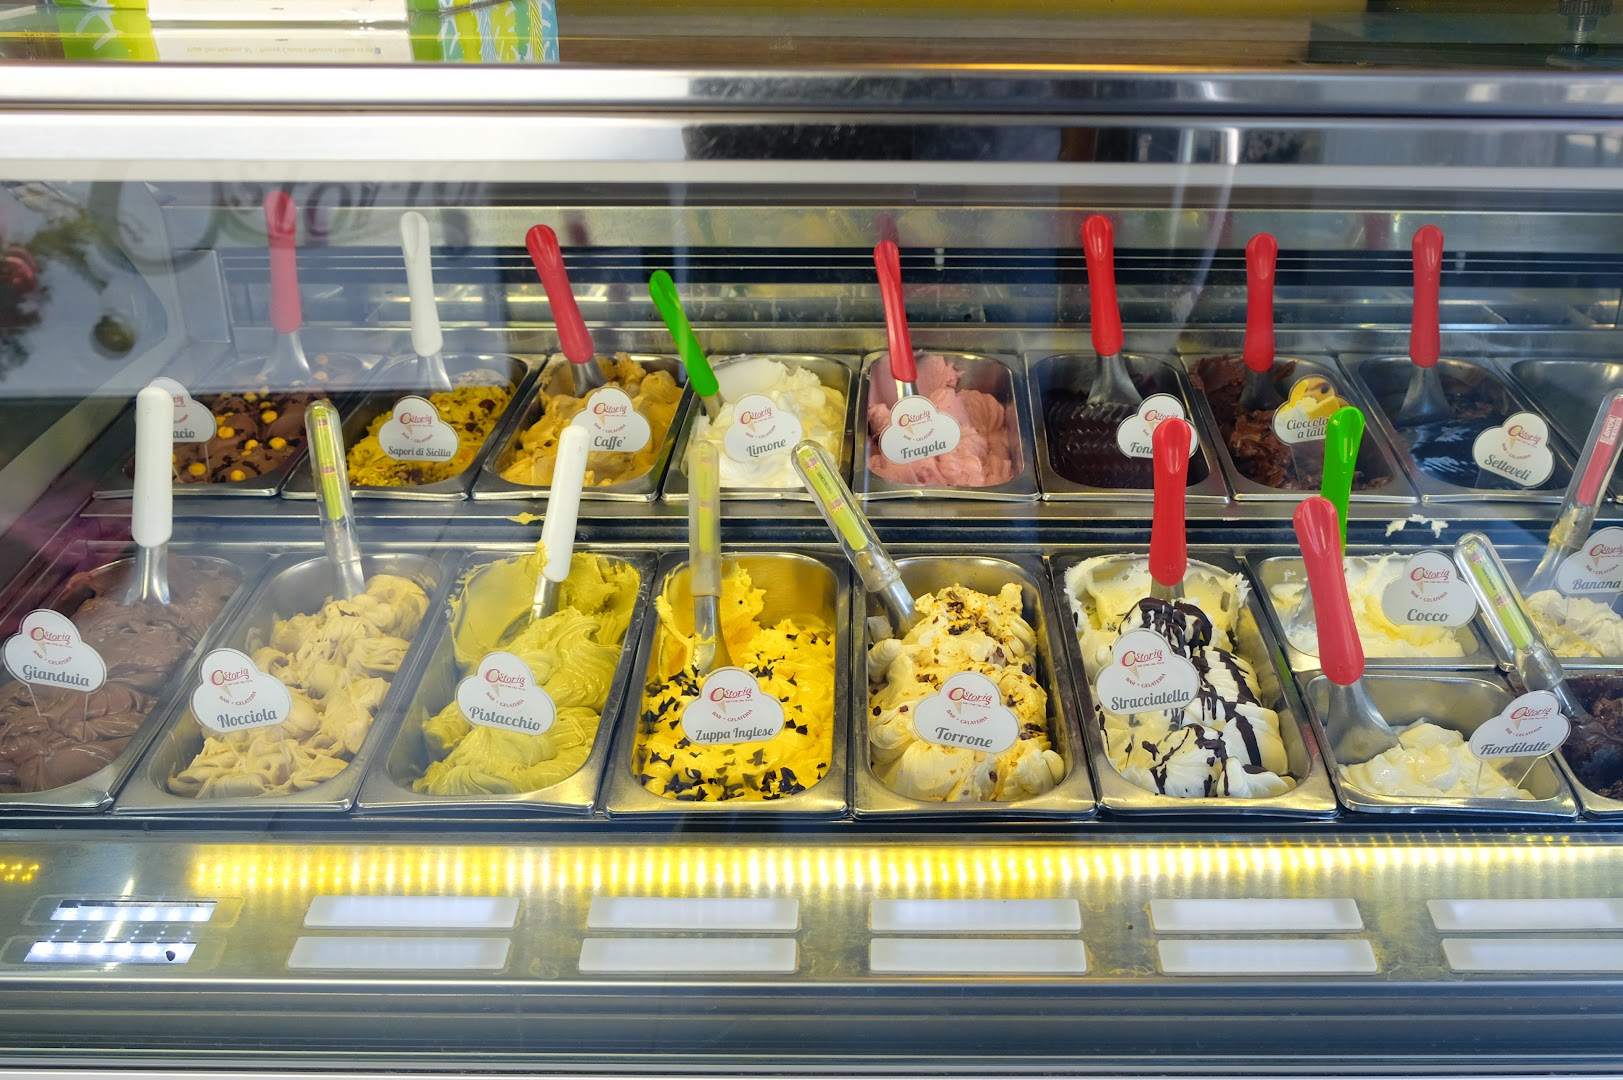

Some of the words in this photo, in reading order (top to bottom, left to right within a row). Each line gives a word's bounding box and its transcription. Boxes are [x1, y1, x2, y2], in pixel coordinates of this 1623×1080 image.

[1287, 417, 1329, 430] Cioccola
[173, 428, 195, 438] acio
[1306, 428, 1326, 438] latt
[388, 446, 414, 457] Sapori
[416, 448, 424, 456] di
[425, 447, 451, 457] Sicilia
[746, 439, 786, 457] Limone
[900, 440, 946, 459] Fragola
[1130, 442, 1153, 454] Fon
[1572, 578, 1622, 590] Banana
[1406, 608, 1449, 622] Cocco
[22, 664, 89, 687] Gianduia
[1111, 689, 1189, 711] Stracciatella
[217, 708, 277, 728] Nocciola
[469, 706, 541, 731] Pistacchio
[695, 729, 731, 743] Zuppa
[732, 726, 774, 740] Inglese
[935, 726, 993, 748] Torrone
[1480, 741, 1551, 755] Fiordilatte
